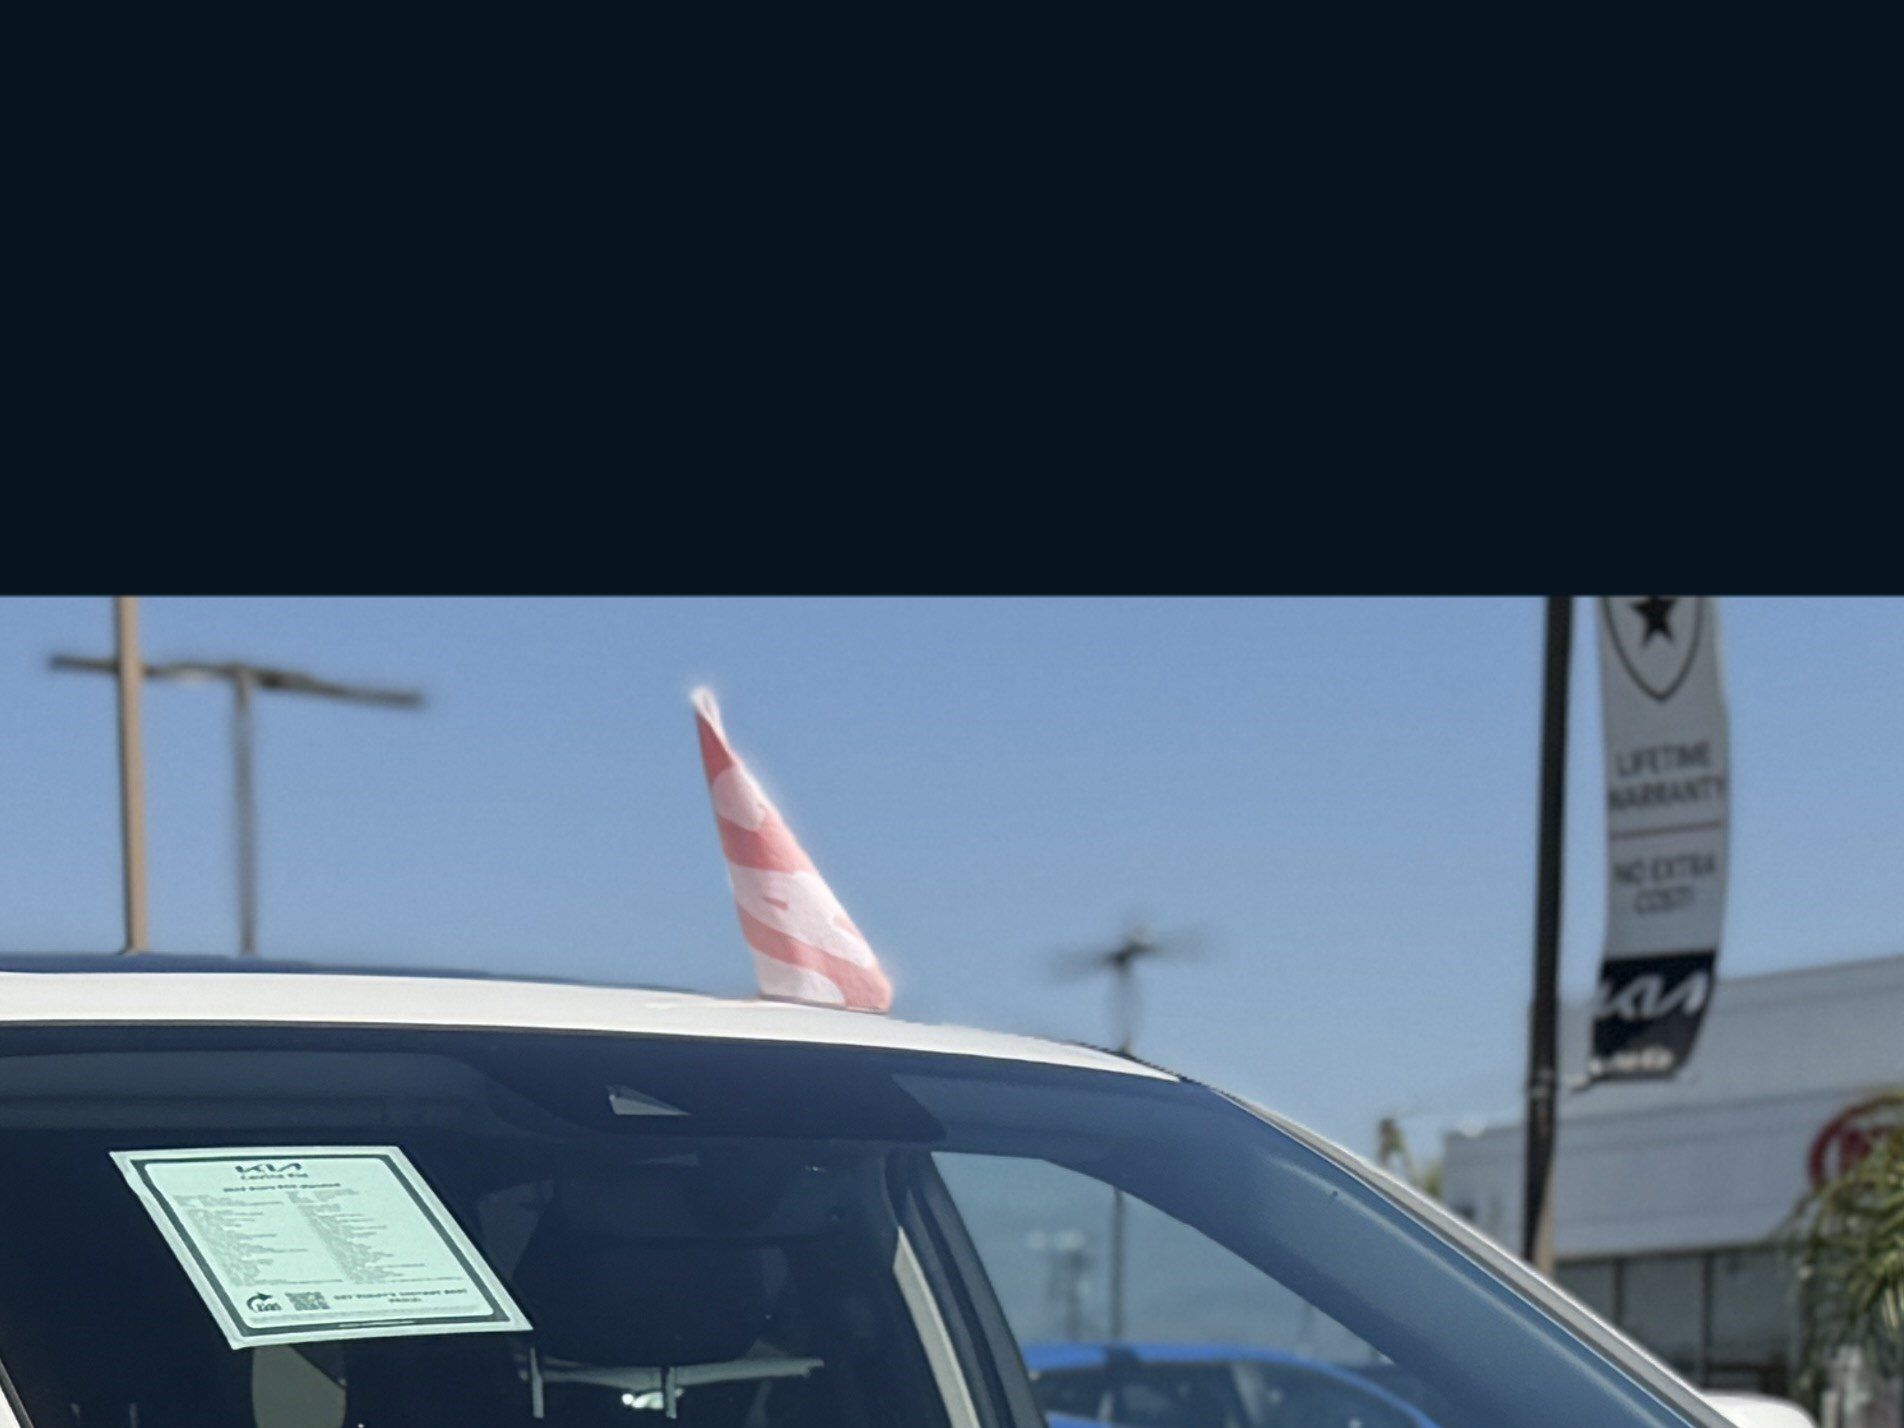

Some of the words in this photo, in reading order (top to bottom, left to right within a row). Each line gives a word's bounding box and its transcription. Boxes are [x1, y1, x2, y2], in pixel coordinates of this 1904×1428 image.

[1616, 741, 1711, 777] LIFETIME
[1607, 774, 1726, 810] WARRANTY
[1651, 850, 1716, 881] EXTRA
